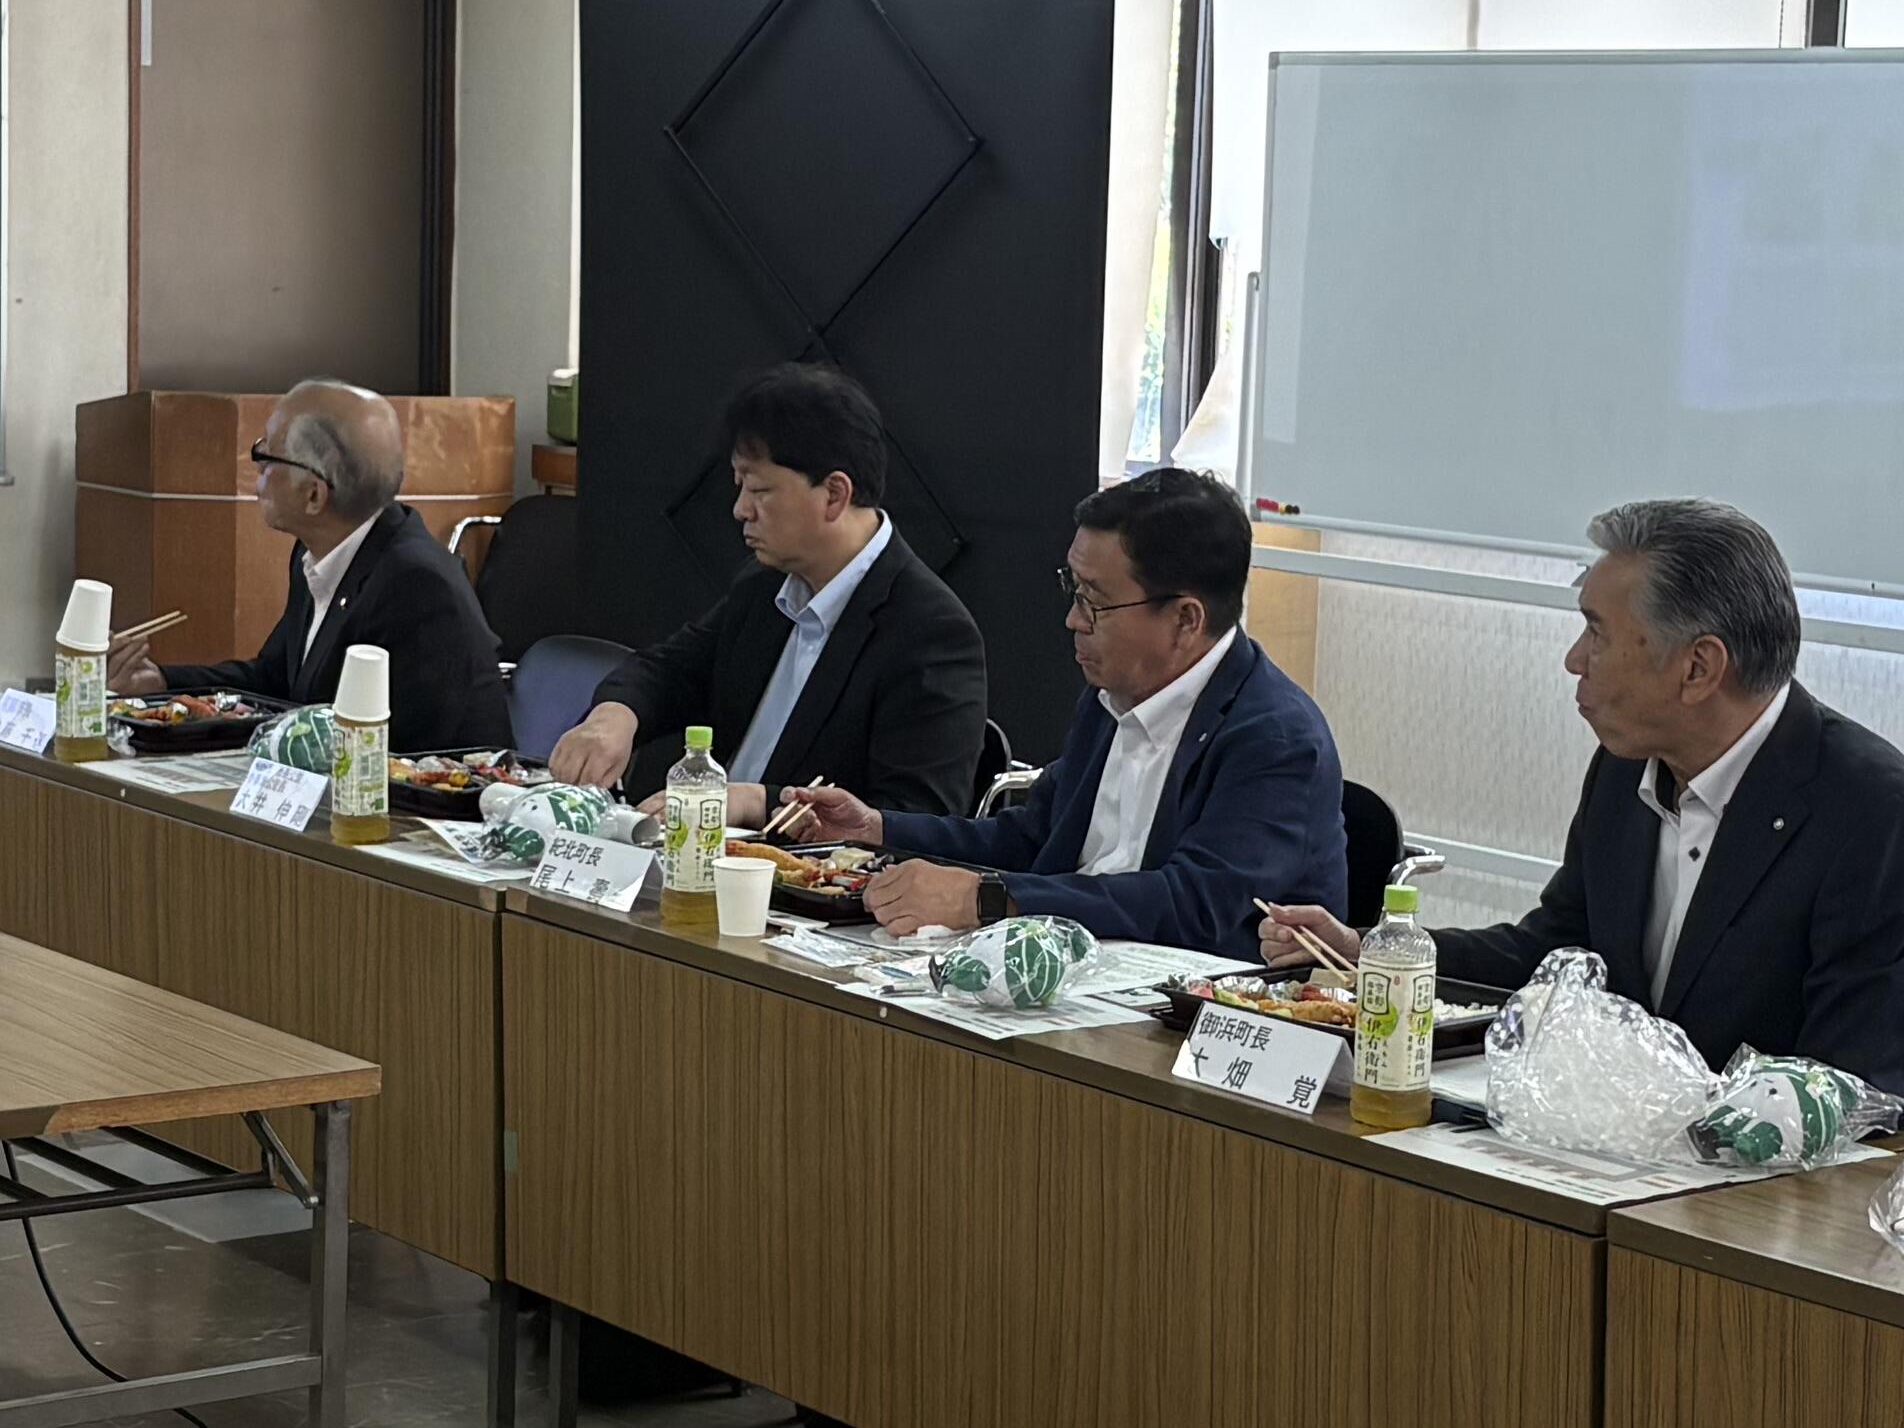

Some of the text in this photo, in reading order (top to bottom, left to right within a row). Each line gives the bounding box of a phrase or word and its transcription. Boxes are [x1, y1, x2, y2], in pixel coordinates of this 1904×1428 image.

[548, 836, 605, 867] 紀北町長
[534, 863, 575, 894] 尾上
[1198, 1010, 1273, 1052] 御浜町長
[1190, 1046, 1318, 1110] 大畑 覚
